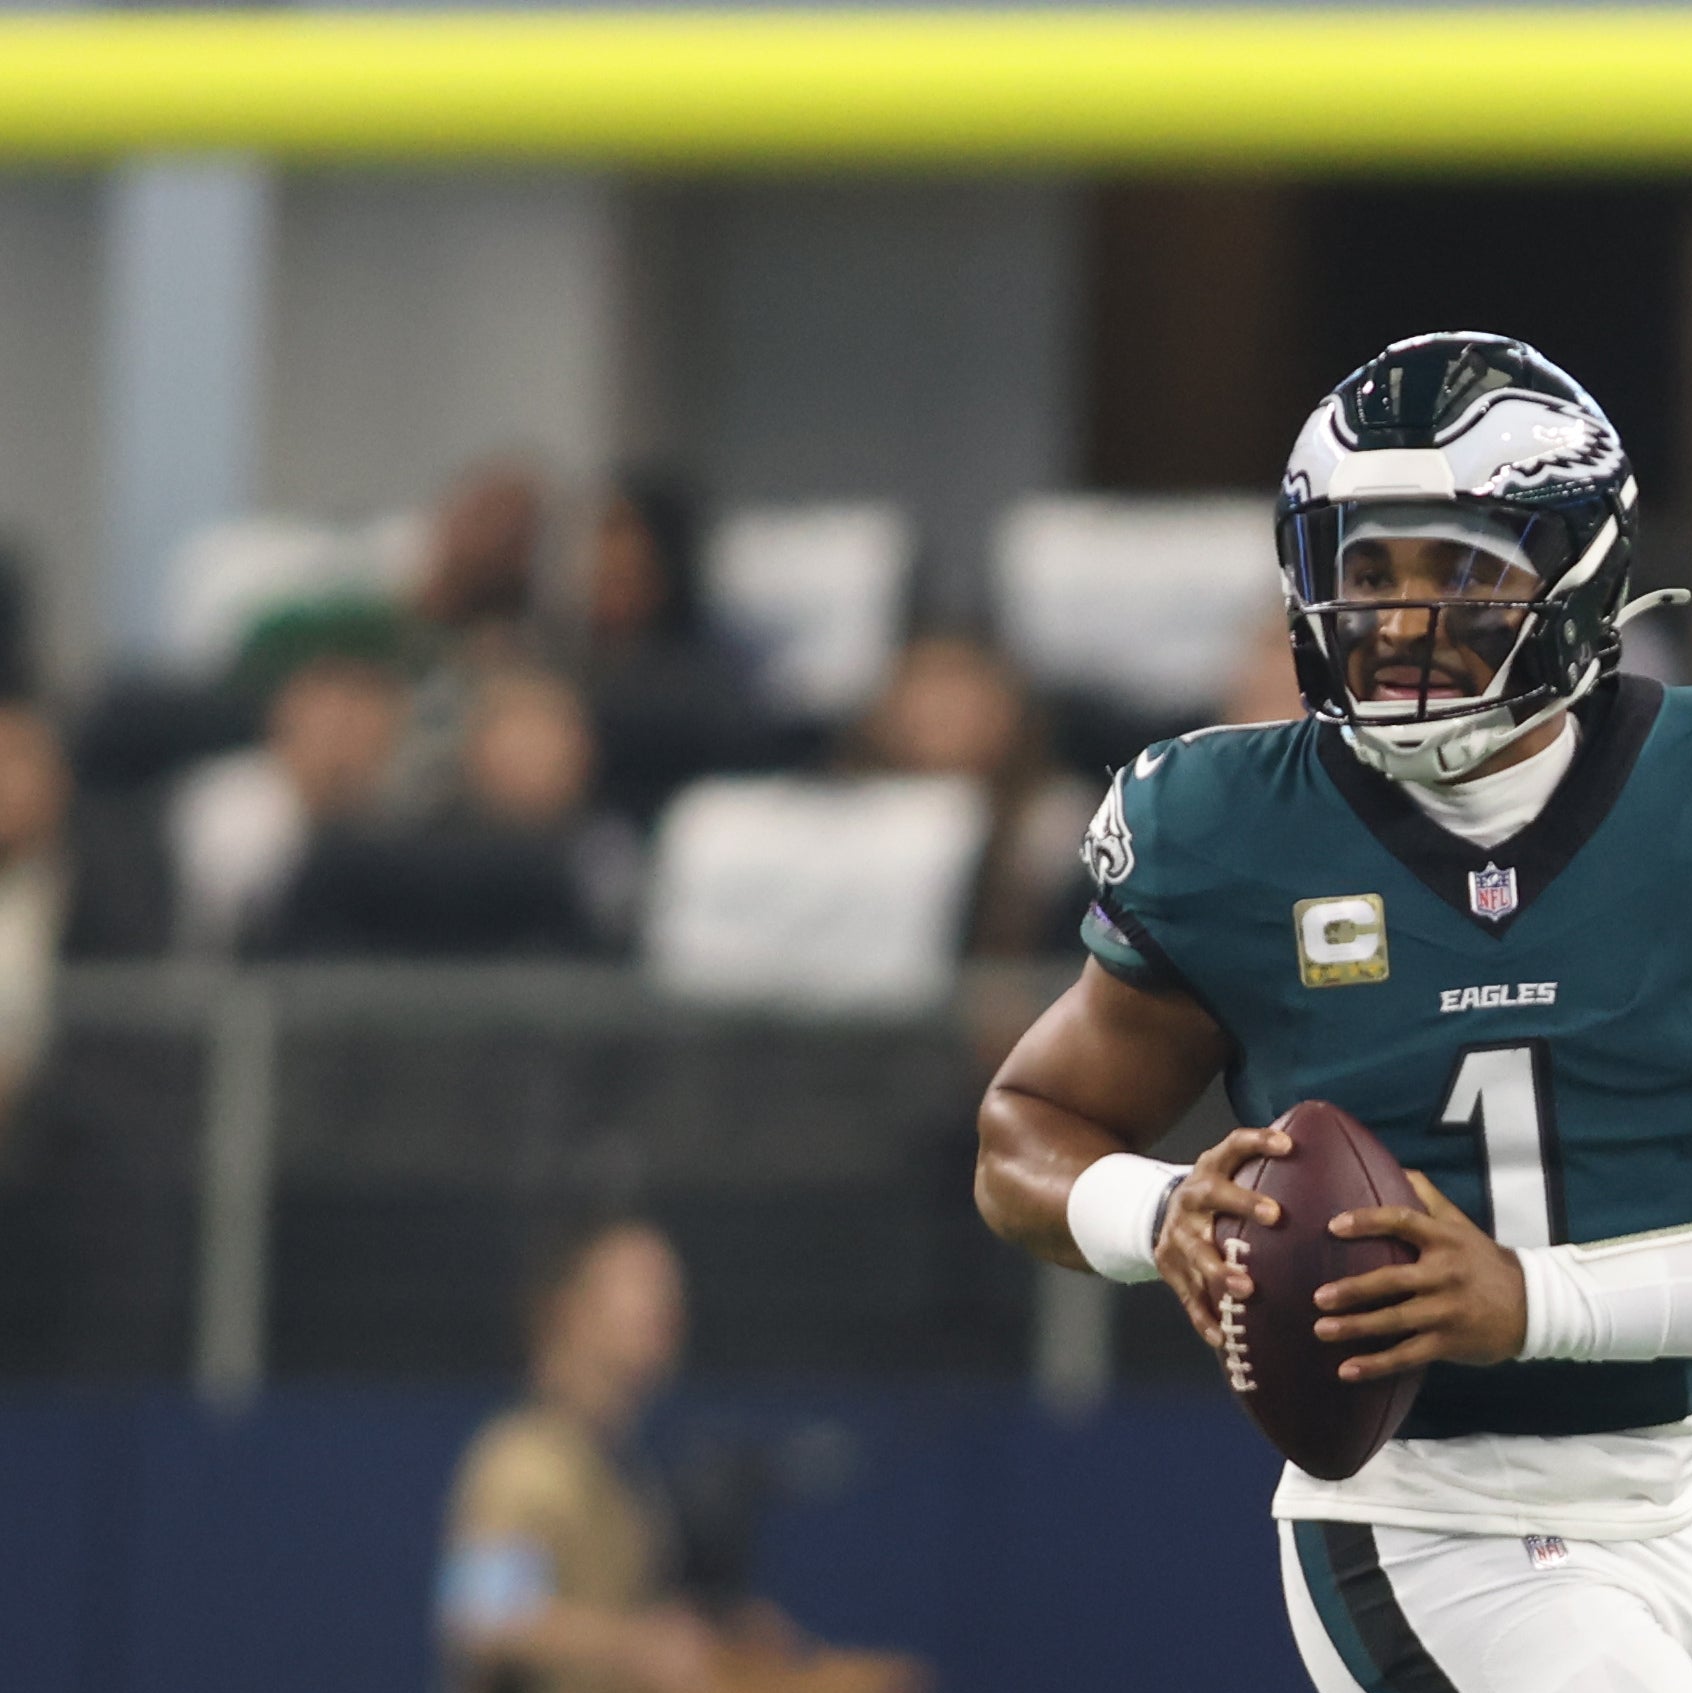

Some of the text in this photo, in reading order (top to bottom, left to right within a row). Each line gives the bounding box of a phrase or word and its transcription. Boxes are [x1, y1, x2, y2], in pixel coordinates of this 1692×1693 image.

[1478, 887, 1512, 910] NFL
[1302, 900, 1379, 963] C
[1439, 981, 1559, 1013] EAGLES
[1440, 1046, 1552, 1250] 1
